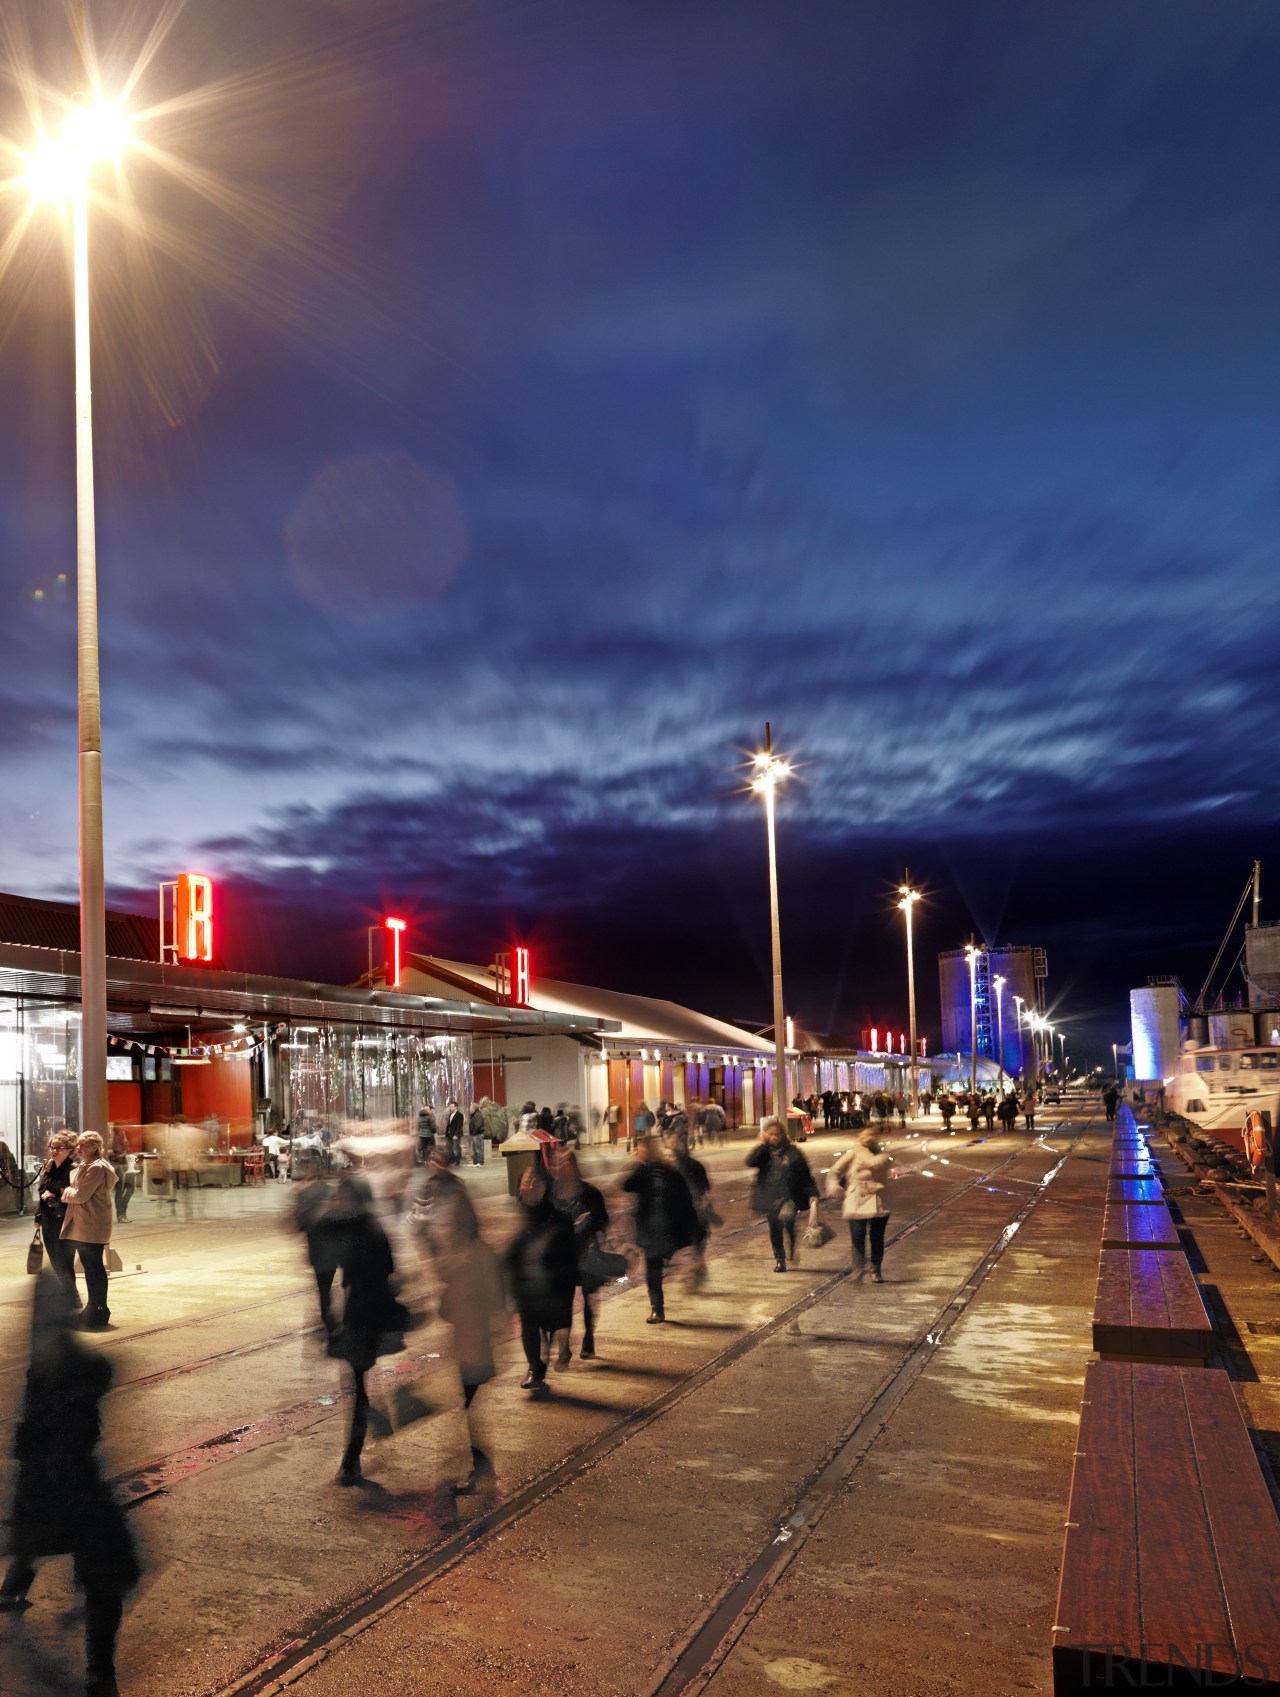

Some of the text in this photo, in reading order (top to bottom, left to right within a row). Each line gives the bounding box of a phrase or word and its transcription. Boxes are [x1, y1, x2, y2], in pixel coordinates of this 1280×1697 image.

[182, 873, 213, 962] R
[385, 917, 407, 987] T
[513, 947, 530, 1004] H
